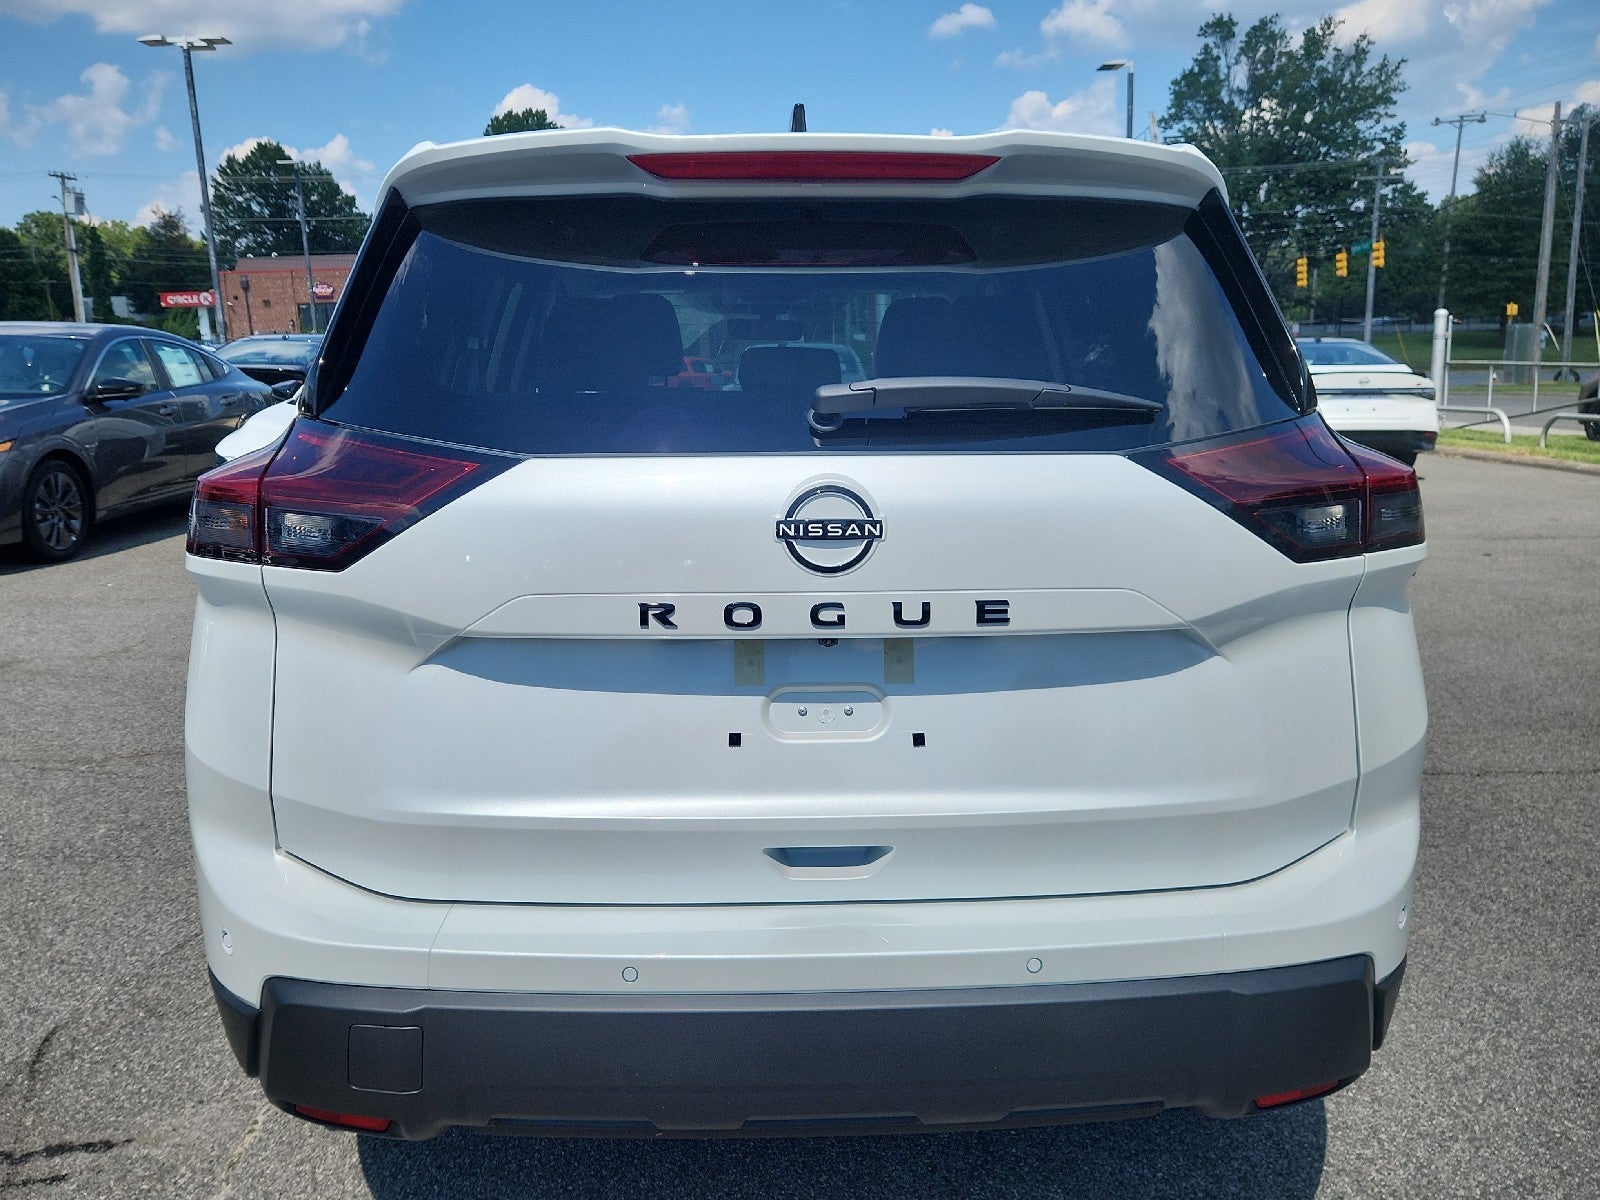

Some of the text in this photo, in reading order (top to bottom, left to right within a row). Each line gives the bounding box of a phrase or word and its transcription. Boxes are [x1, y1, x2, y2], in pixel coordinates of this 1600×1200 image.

[166, 294, 199, 304] CIRCLE
[779, 523, 881, 537] NISSAN
[638, 600, 1011, 630] ROGUE
